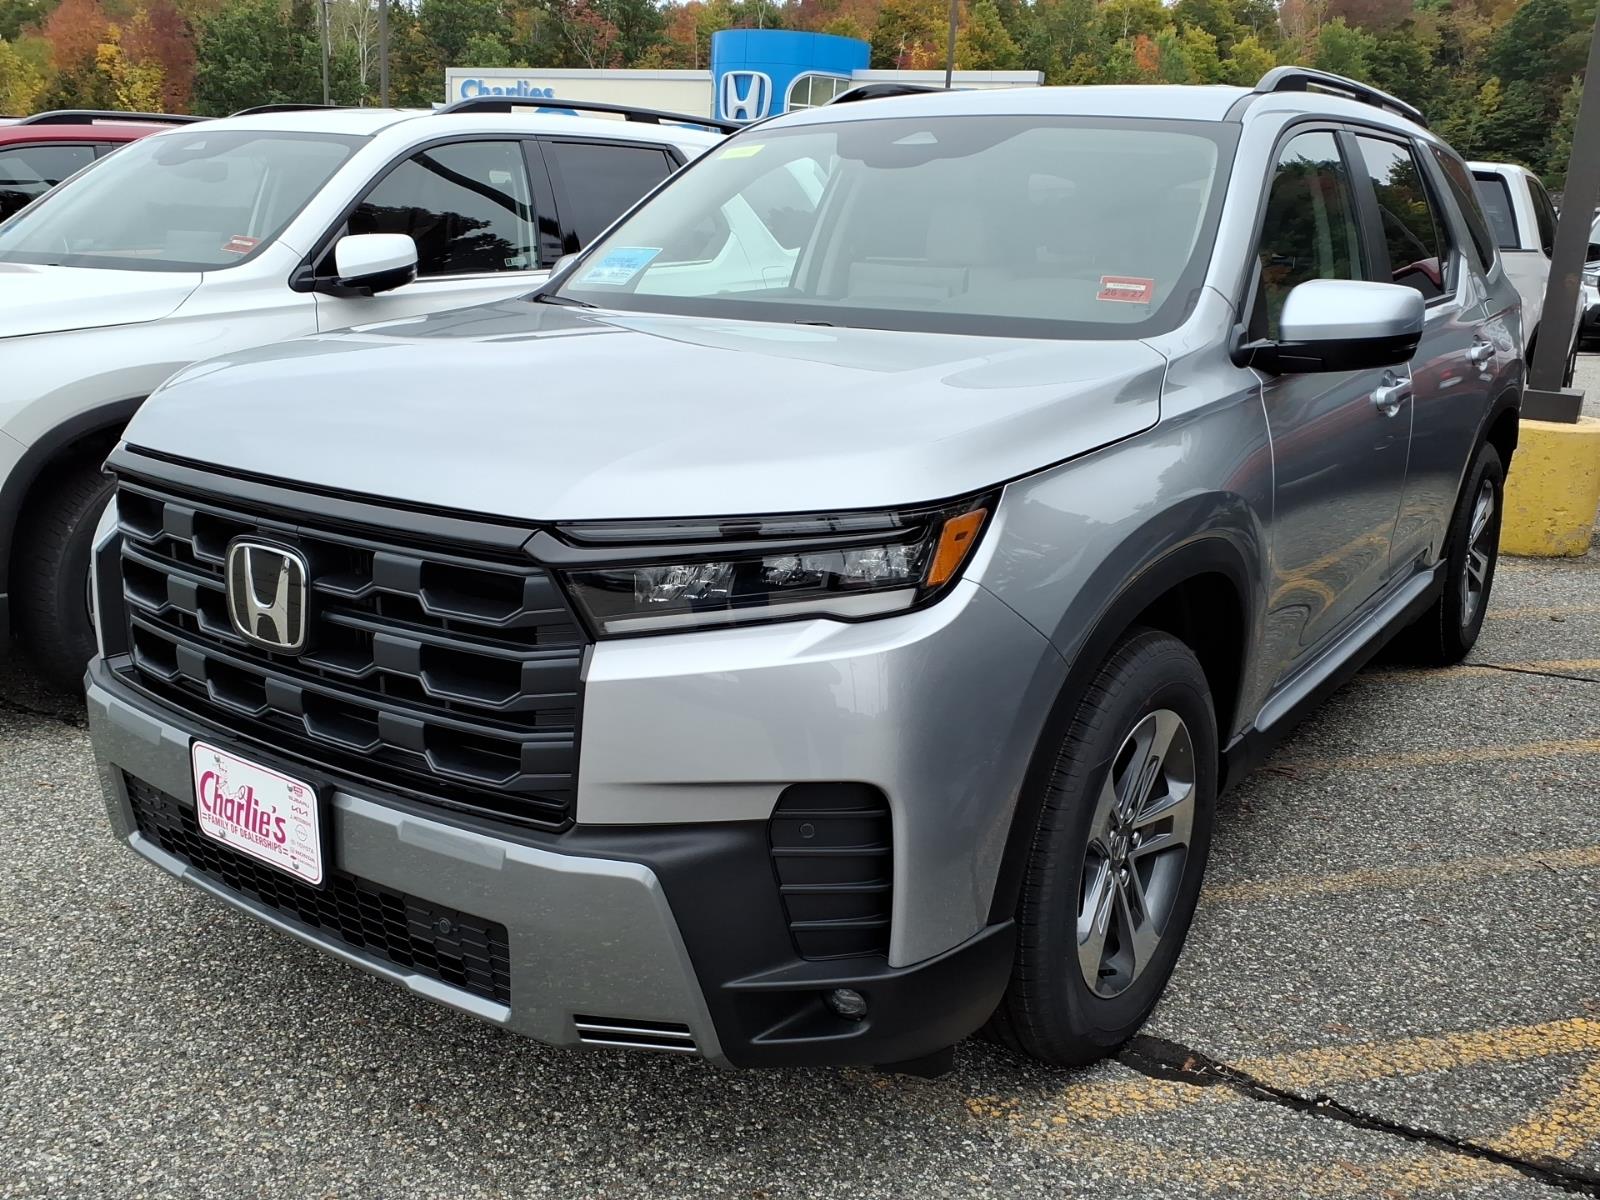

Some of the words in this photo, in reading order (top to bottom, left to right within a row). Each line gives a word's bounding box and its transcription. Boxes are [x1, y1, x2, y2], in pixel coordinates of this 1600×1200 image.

[200, 771, 286, 844] Charlie's
[207, 813, 229, 831] FAMILY
[231, 822, 239, 834] OF
[240, 826, 283, 855] DEALERSHIPS
